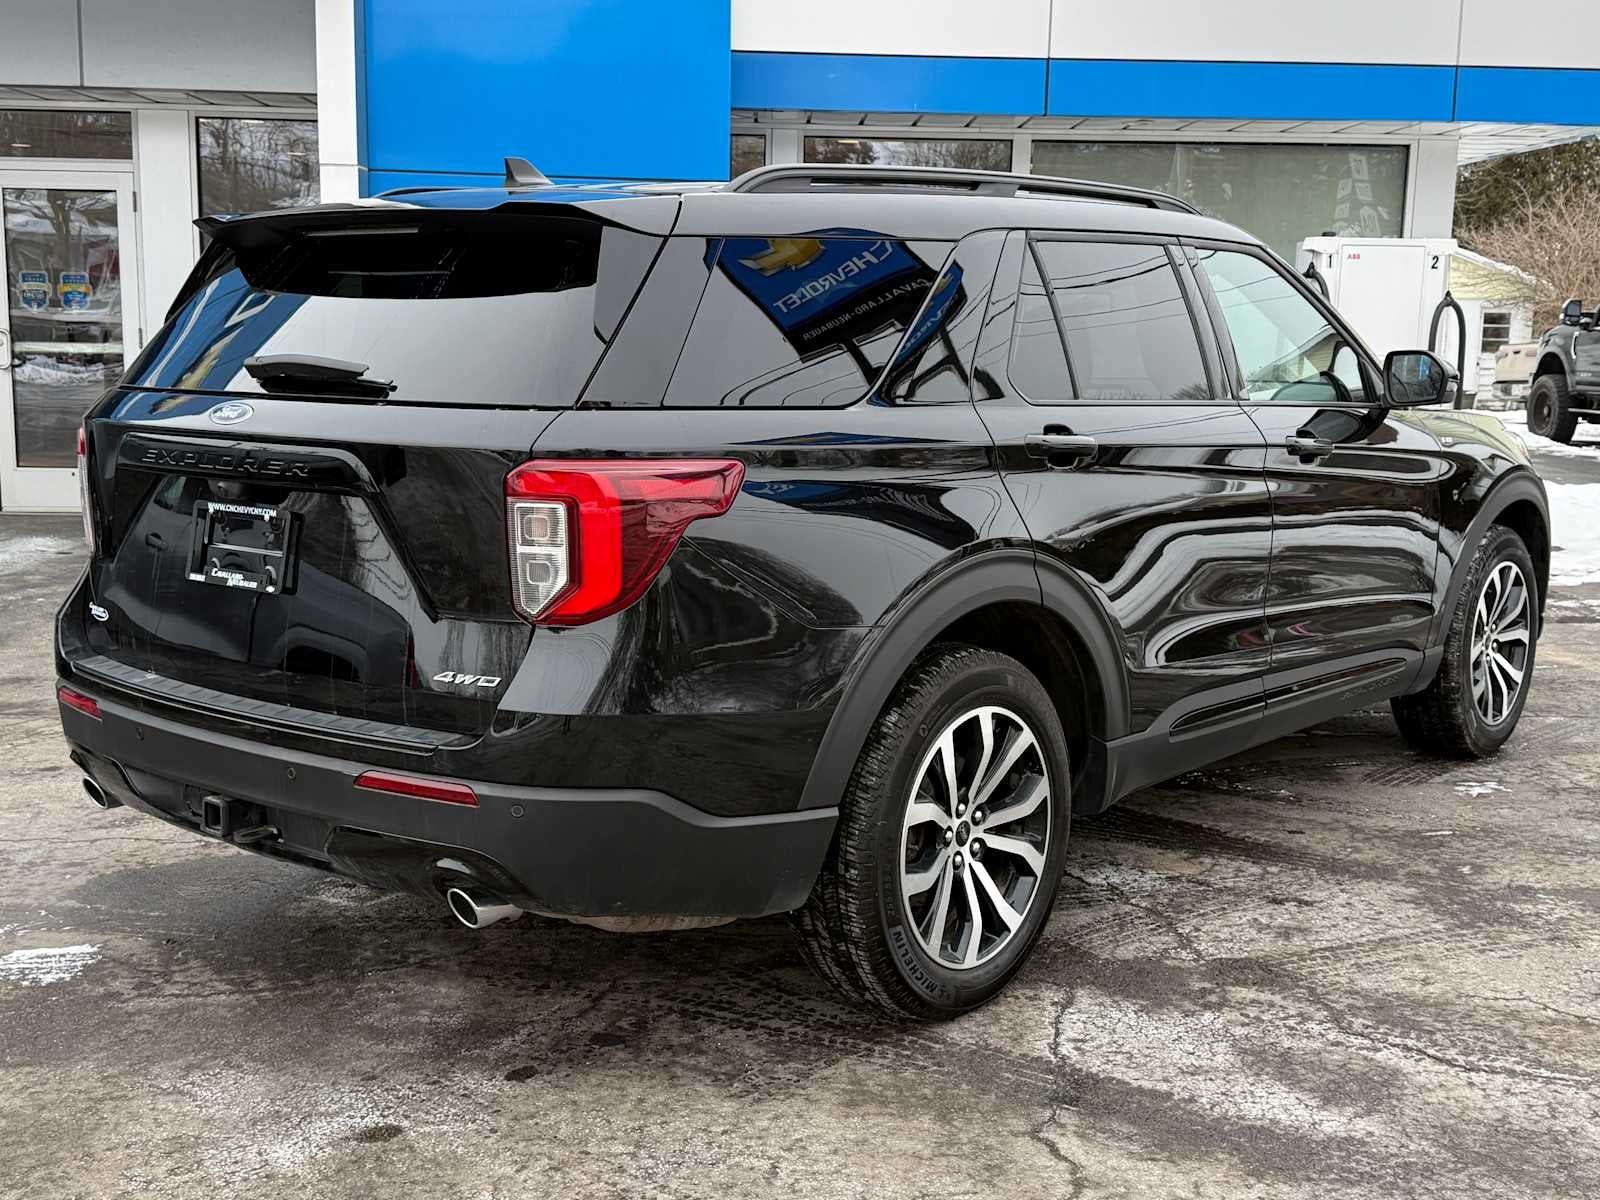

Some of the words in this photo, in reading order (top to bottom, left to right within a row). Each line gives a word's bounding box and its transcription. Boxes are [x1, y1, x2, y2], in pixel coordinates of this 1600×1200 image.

[1327, 254, 1333, 269] 1
[1430, 255, 1440, 270] 2
[141, 449, 309, 478] EXPLORER
[433, 671, 502, 687] 4WD
[893, 929, 938, 993] MICHELIN
